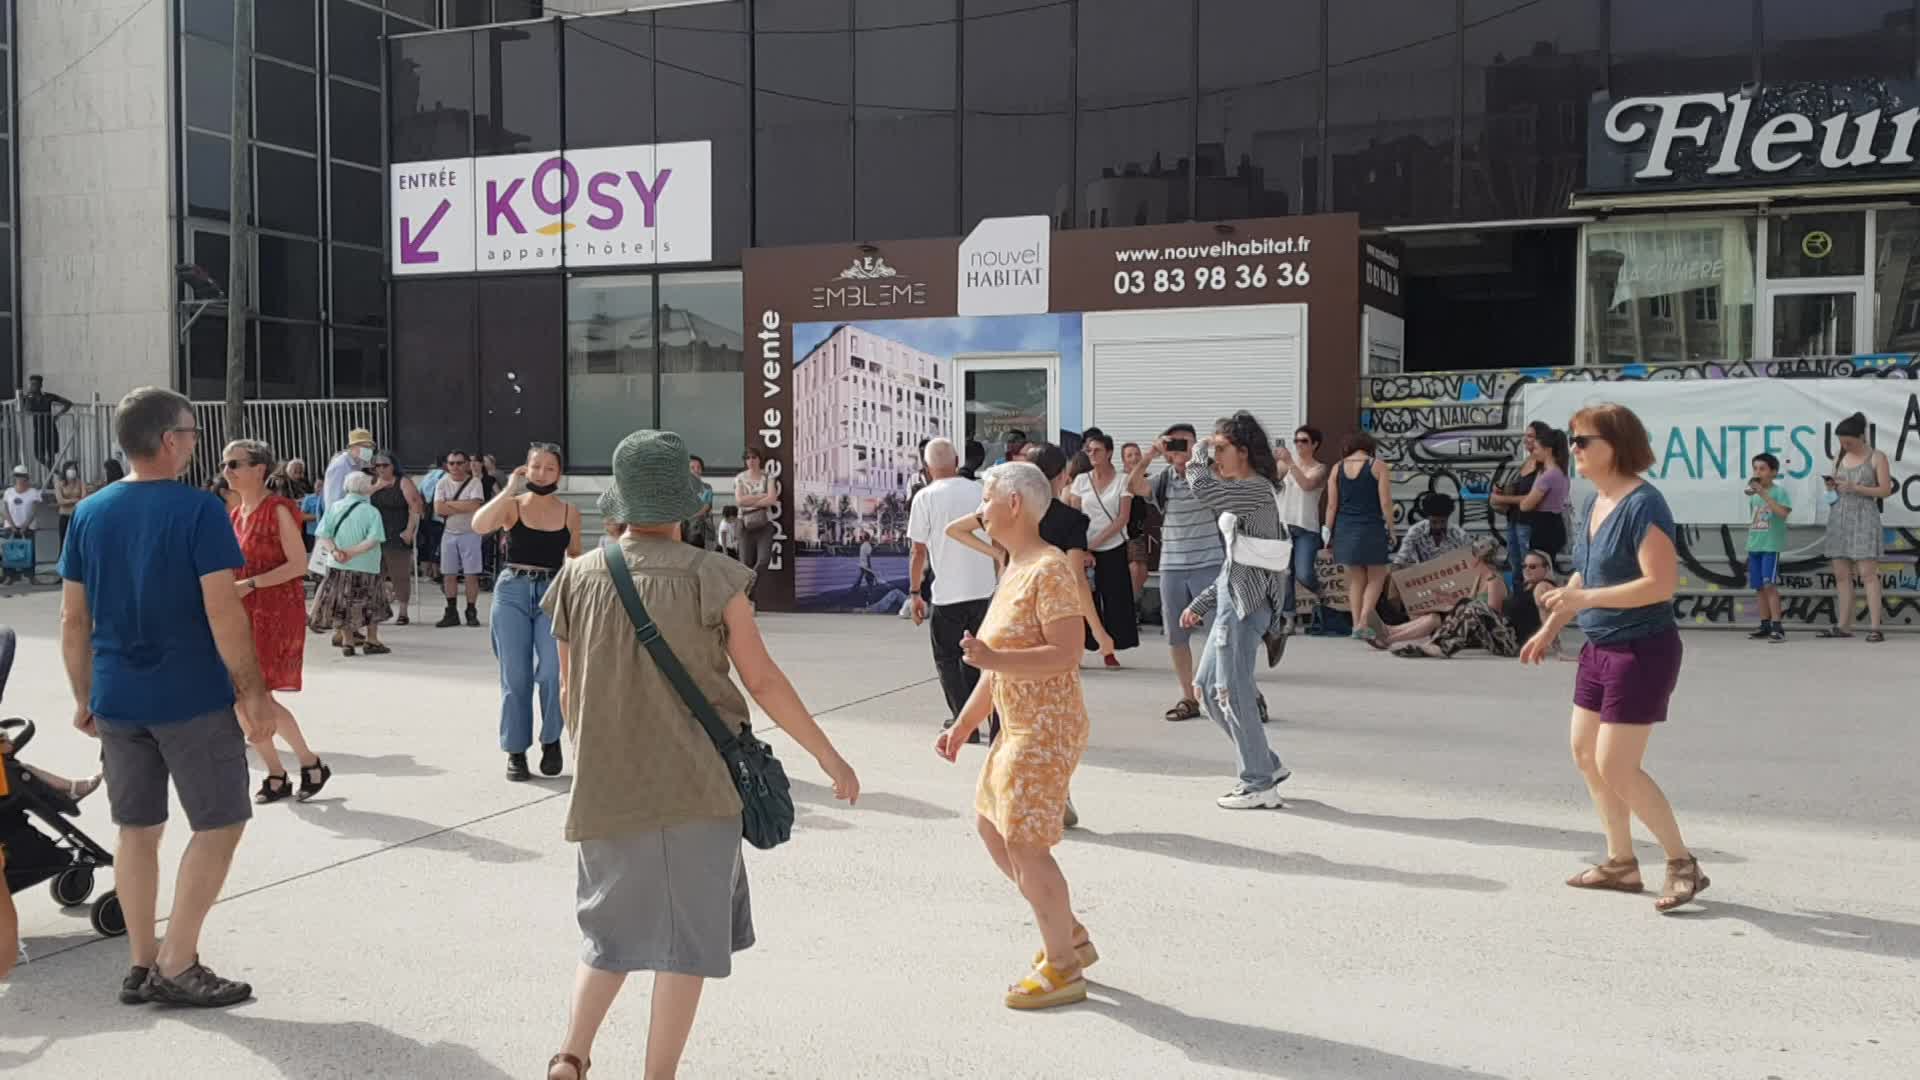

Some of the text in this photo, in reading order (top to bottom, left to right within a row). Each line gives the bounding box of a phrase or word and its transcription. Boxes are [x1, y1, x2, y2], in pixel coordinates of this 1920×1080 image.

[399, 166, 457, 190] ENTRÉE
[486, 156, 672, 236] KOSY
[970, 242, 1041, 267] nouvel
[1115, 236, 1311, 262] www.nouvelhabitat.fr
[967, 268, 1043, 288] HABITAT
[1114, 262, 1310, 294] 03 83 98 36 36
[758, 309, 781, 398] vente
[759, 408, 782, 449] de
[1440, 407, 1494, 426] NANCY
[1477, 436, 1521, 455] NANCY
[1647, 425, 1816, 479] ANTES
